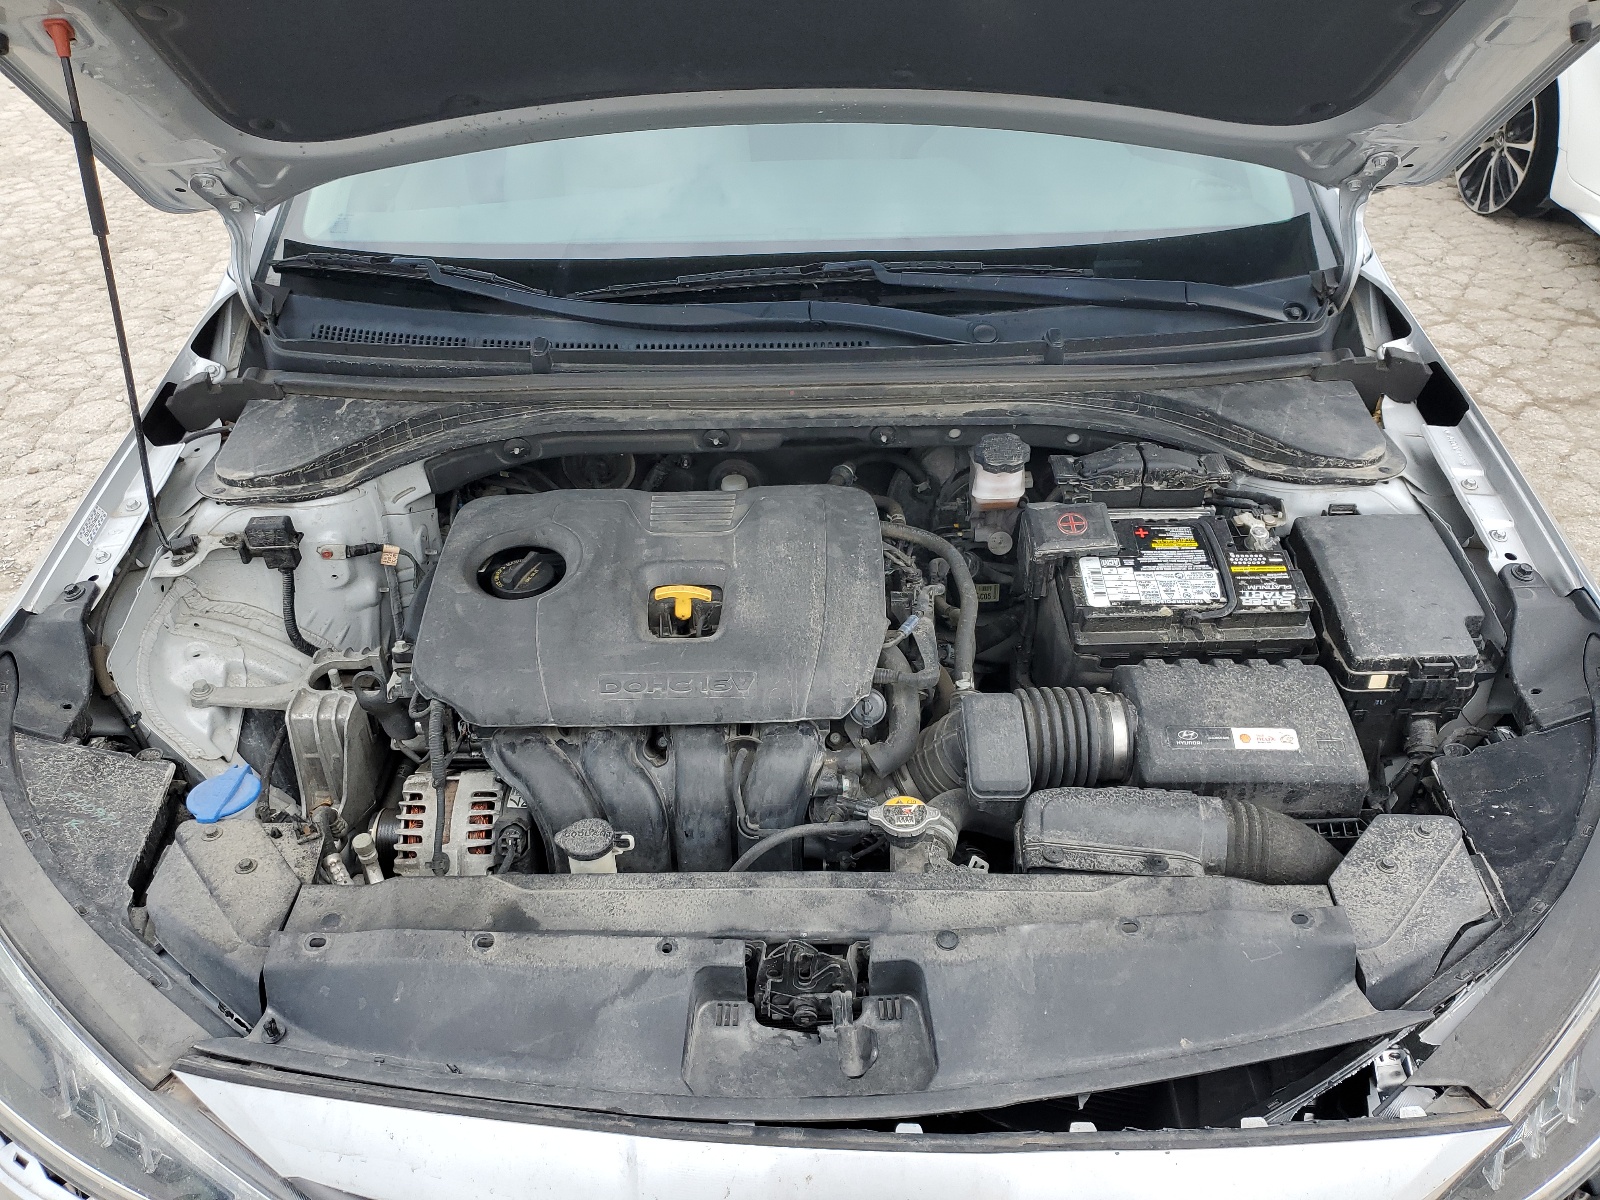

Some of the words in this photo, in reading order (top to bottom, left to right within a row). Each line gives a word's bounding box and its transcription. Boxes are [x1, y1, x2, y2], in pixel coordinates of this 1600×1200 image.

[1239, 590, 1296, 600] START
[600, 676, 693, 694] DOHC
[699, 673, 757, 694] 16V
[562, 829, 612, 838] COOLANT
